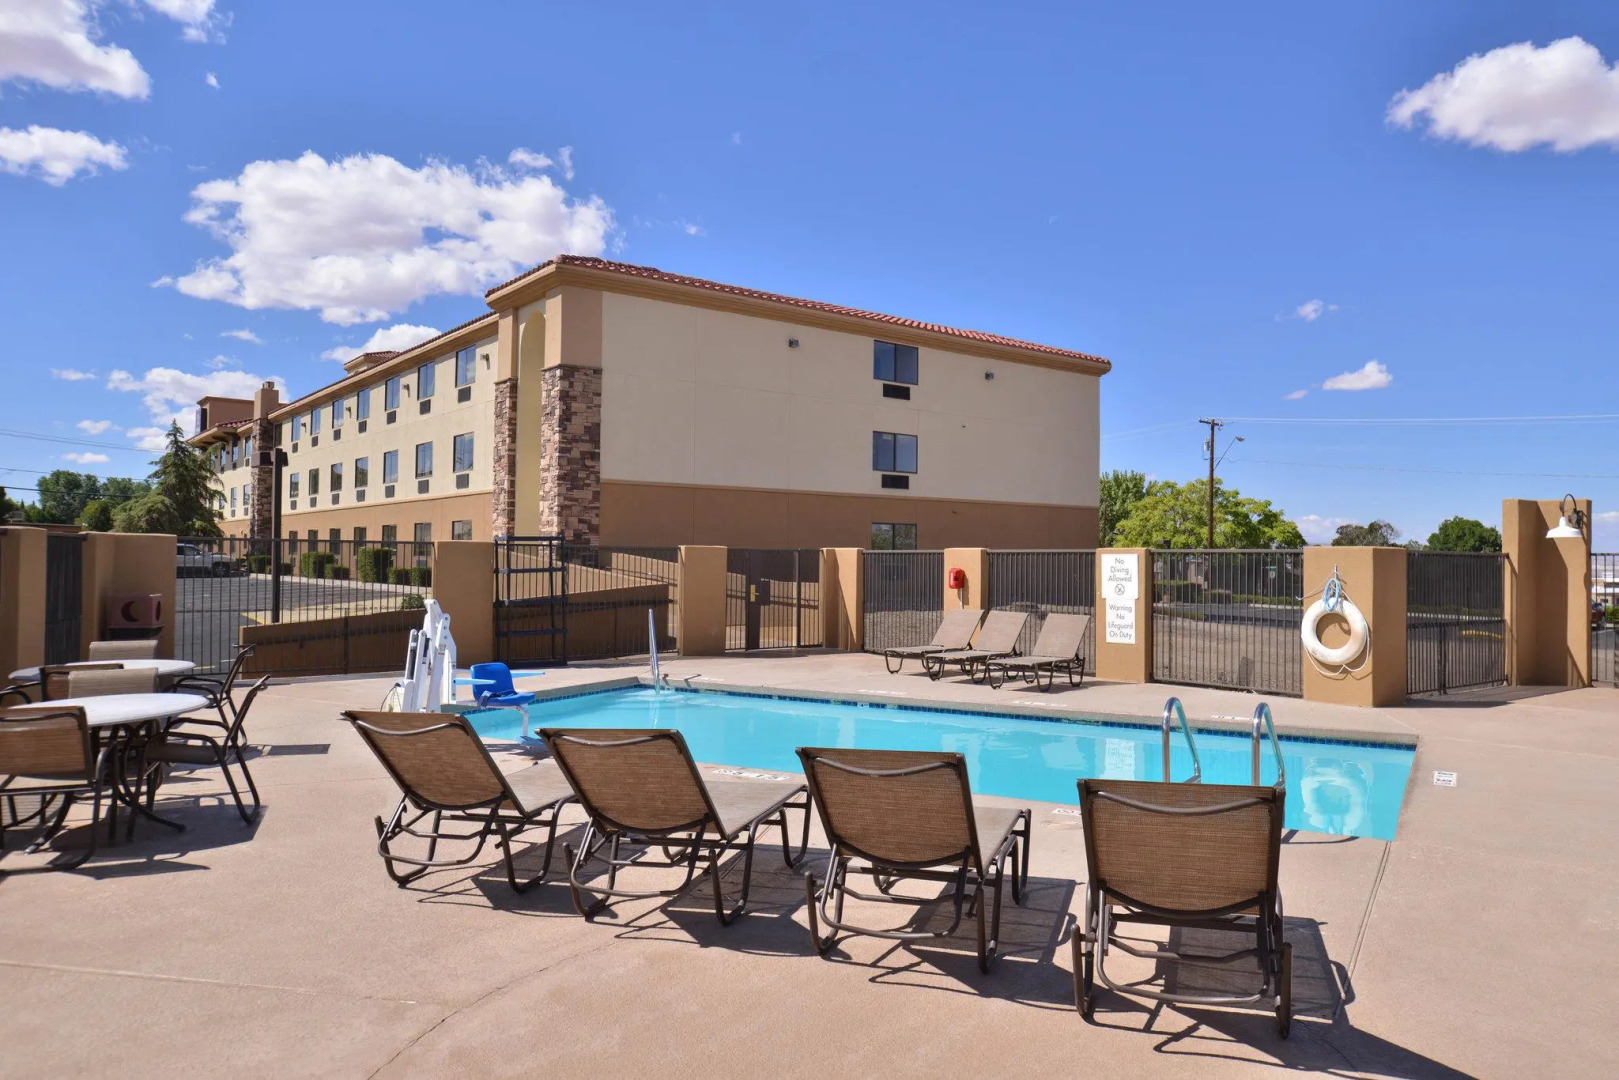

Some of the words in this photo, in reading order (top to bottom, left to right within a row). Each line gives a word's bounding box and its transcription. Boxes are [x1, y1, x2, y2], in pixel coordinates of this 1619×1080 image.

[1115, 557, 1125, 565] No
[1110, 566, 1130, 576] Diving
[1108, 574, 1132, 583] Allowed
[1109, 603, 1132, 614] Warning
[1108, 621, 1134, 631] Lifeguard
[1109, 630, 1118, 638] On
[1119, 631, 1132, 640] Duty
